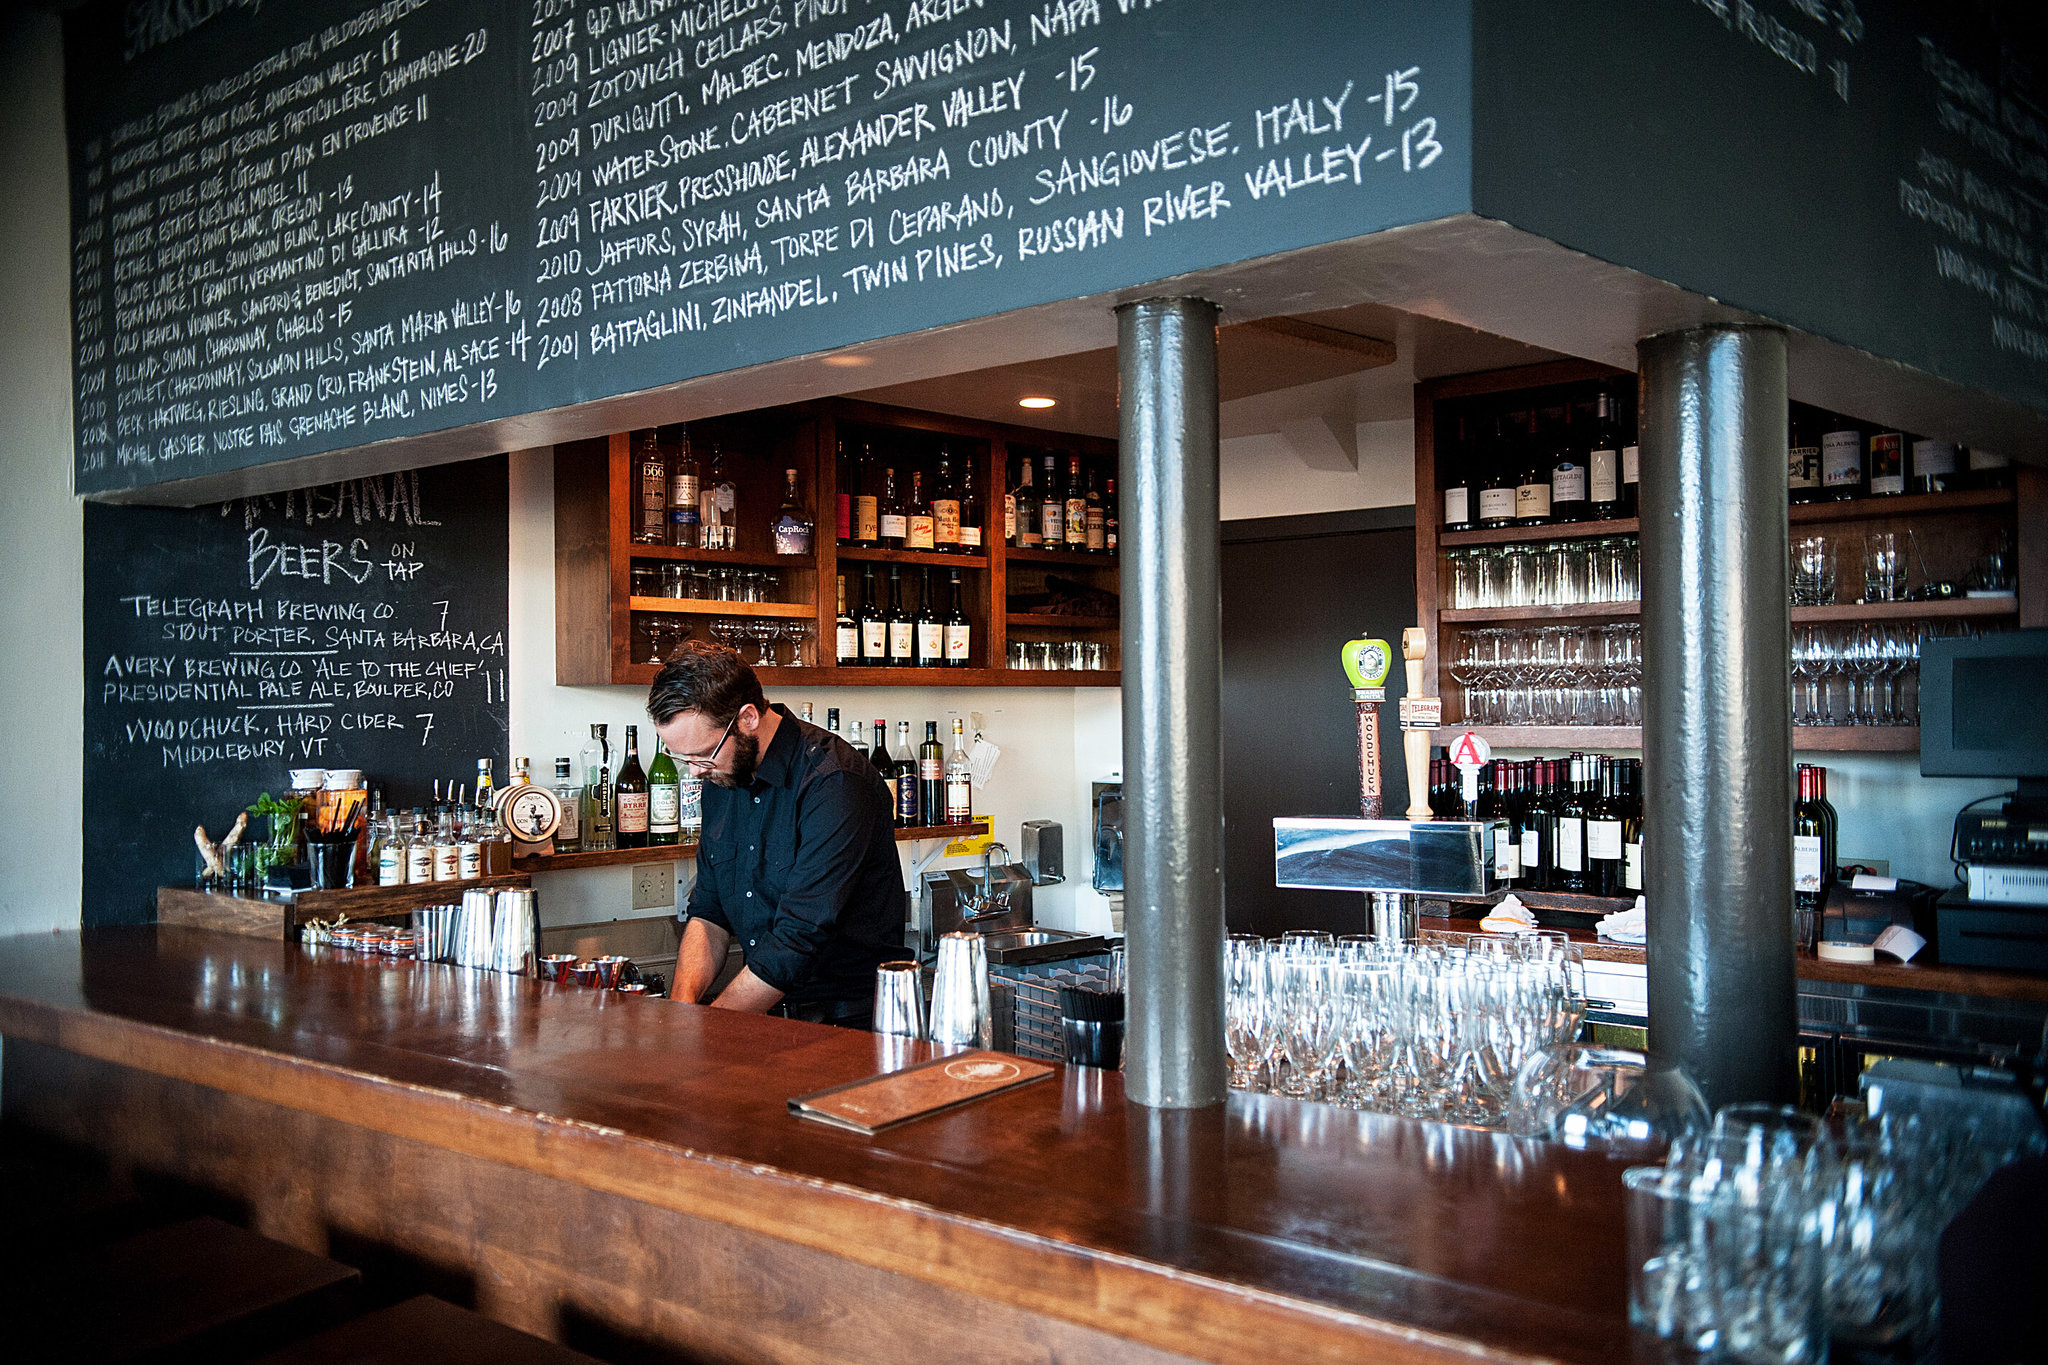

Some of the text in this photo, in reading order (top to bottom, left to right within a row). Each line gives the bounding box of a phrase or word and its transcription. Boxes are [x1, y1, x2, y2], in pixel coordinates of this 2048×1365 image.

[532, 19, 575, 63] 2007
[379, 44, 460, 98] CHAMPAGNE
[531, 53, 578, 95] 2009
[535, 6, 788, 127] 2009 ZOTOVICH CELLARS,
[536, 170, 581, 208] 2009
[731, 74, 860, 144] CABERNET
[1030, 0, 1100, 45] NAPA
[537, 128, 579, 173] 2009
[702, 54, 790, 105] MALBEC,
[797, 13, 900, 77] MENDOZA,
[322, 130, 342, 157] EN
[345, 104, 408, 149] PROVENCE
[536, 207, 579, 248] 2009
[588, 180, 679, 234] FARRIER,
[678, 150, 797, 210] PRESSHOUSE,
[799, 103, 936, 168] ALEXANDER
[942, 69, 1026, 128] VALLEY
[249, 181, 290, 209] MOSEL
[272, 192, 322, 230] OREGON
[327, 210, 358, 238] LAKE
[360, 191, 412, 227] COUNTY
[536, 249, 581, 283] 2010
[585, 226, 676, 276] JAFFURS,
[682, 209, 748, 253] SYRAH,
[755, 183, 831, 228] SANTA
[845, 147, 950, 206] BARBARA
[968, 109, 1069, 169] COUNTY
[536, 287, 581, 328] 2008
[592, 264, 672, 311] FATTORIA
[679, 241, 769, 290] ZERBINA,
[770, 225, 839, 265] TORRE
[850, 216, 874, 248] DI
[889, 187, 1014, 245] CEPARANO,
[1255, 80, 1355, 149] ITALY
[331, 241, 345, 266] DI
[352, 225, 408, 260] GALLURA
[590, 301, 707, 356] BATTAGLINI,
[712, 275, 838, 324] ZINFANDEL,
[842, 256, 908, 295] TWIN
[915, 233, 1003, 281] PINES,
[1018, 206, 1124, 261] RUSSIAN
[1143, 181, 1232, 237] RIVER
[1245, 134, 1372, 200] VALLEY
[114, 332, 140, 357] COLD
[241, 291, 289, 324] SANFORD
[305, 268, 362, 305] BENEDICT,
[439, 228, 477, 267] HILLS
[167, 359, 246, 399] CHARDONNAY,
[247, 350, 300, 382] SOLOMON
[305, 337, 349, 370] HILLS,
[351, 323, 394, 355] SANTA
[401, 310, 448, 344] MARIA
[451, 291, 496, 329] VALLEY
[276, 308, 323, 342] CHABLIS
[208, 388, 268, 422] RIESLING,
[271, 383, 312, 408] GRAND
[317, 373, 346, 401] CRU,
[443, 337, 499, 373] ALSACE
[83, 452, 104, 472] 2011
[116, 443, 155, 467] MICHEL
[213, 425, 254, 454] NOSTRE
[288, 405, 356, 440] GRENACHE
[363, 389, 415, 426] BLANC,
[420, 374, 468, 410] NIMES
[643, 464, 664, 478] 666
[390, 541, 416, 559] ON
[778, 524, 810, 535] CapRock
[247, 526, 374, 590] BEERS
[380, 561, 425, 581] TAP
[120, 596, 450, 631] TELEGRAPH BREWING 7
[162, 623, 386, 650] STOUT PORTER, SANTA
[104, 654, 421, 679] AVERY BREWING TO THE
[104, 680, 351, 704] PRESIDENTIAL PALE ALE,
[1411, 704, 1440, 714] TELEGRAPH
[277, 713, 332, 737] HARD
[341, 714, 404, 730] CIDER
[416, 714, 435, 746] 7
[301, 737, 329, 758] VT
[1363, 713, 1376, 794] WOODCHUCK
